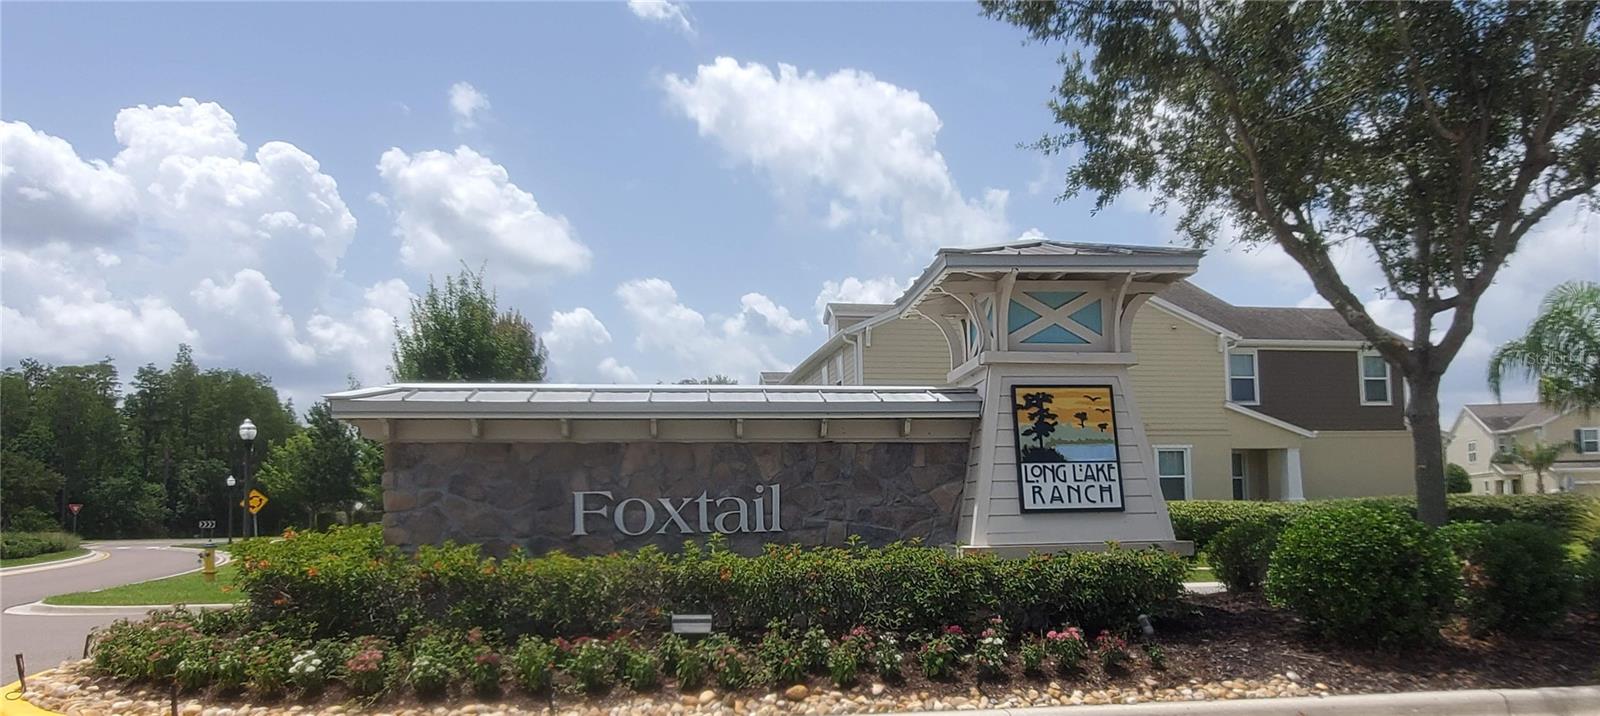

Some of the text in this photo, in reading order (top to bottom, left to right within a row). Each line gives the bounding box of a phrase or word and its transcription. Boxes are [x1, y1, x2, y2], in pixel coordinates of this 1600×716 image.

[1023, 463, 1116, 484] LONG LAKE
[1031, 484, 1114, 505] RANCH
[571, 483, 785, 537] Foxtail
